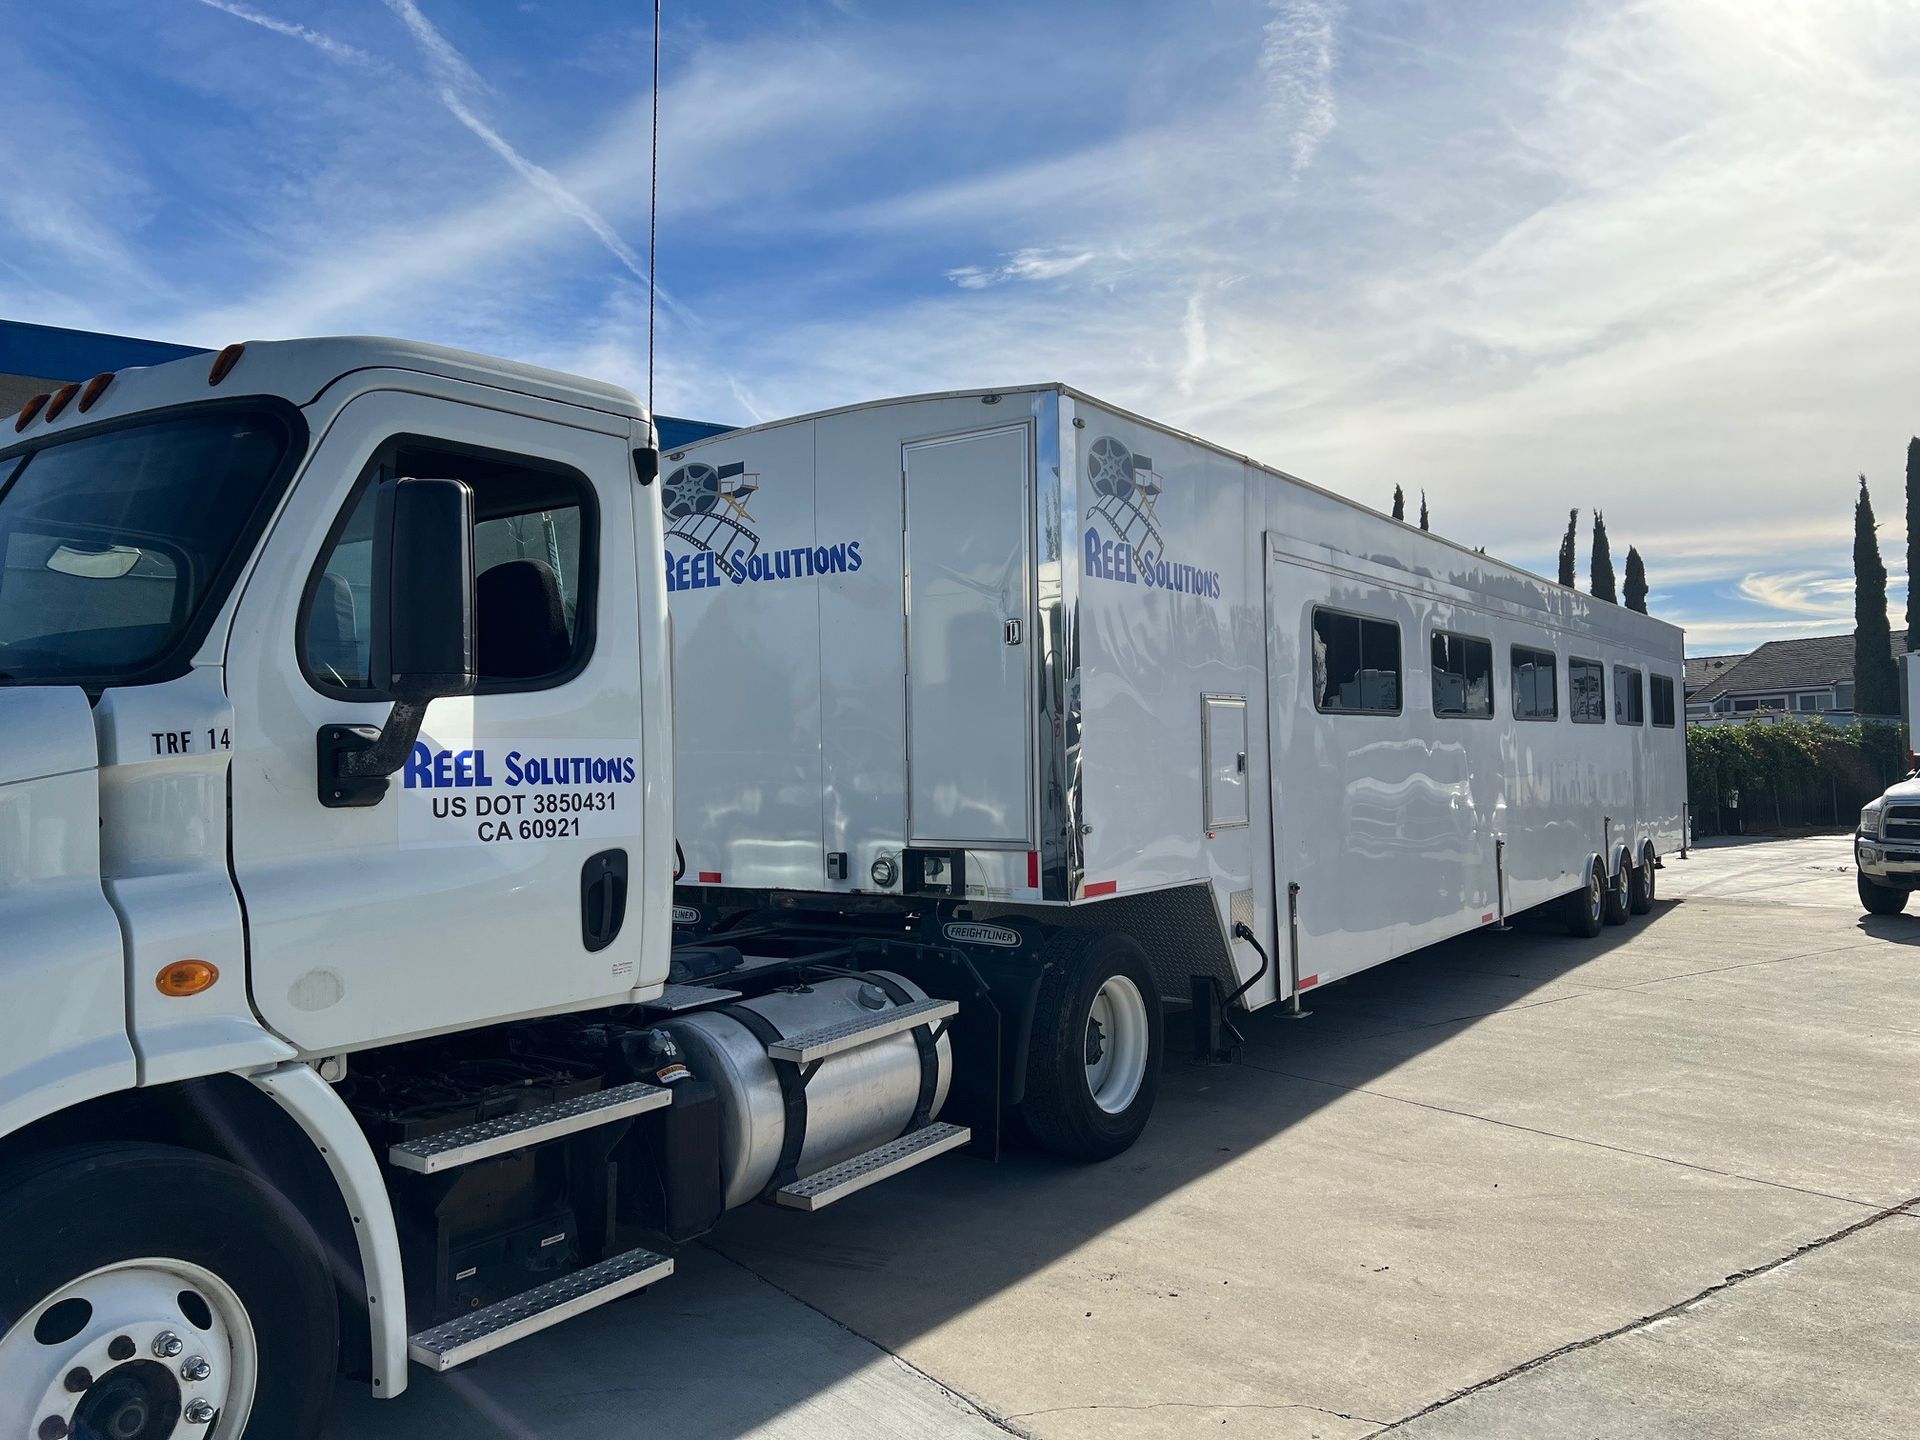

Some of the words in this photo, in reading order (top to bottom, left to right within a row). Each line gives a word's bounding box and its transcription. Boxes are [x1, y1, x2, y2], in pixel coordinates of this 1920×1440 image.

[731, 541, 863, 585] SOLUTIONS
[1084, 526, 1137, 584] REEL
[1144, 550, 1221, 600] SOLUTIONS
[152, 731, 191, 755] TRF
[207, 728, 231, 750] 14
[403, 740, 492, 789] REEL
[505, 751, 636, 787] SOLUTIONS
[432, 797, 467, 818] US
[475, 794, 526, 817] DOT
[533, 791, 616, 814] 3850431
[477, 821, 514, 842] CA
[519, 817, 580, 840] 60921
[950, 927, 1014, 942] FREIGHTLINER
